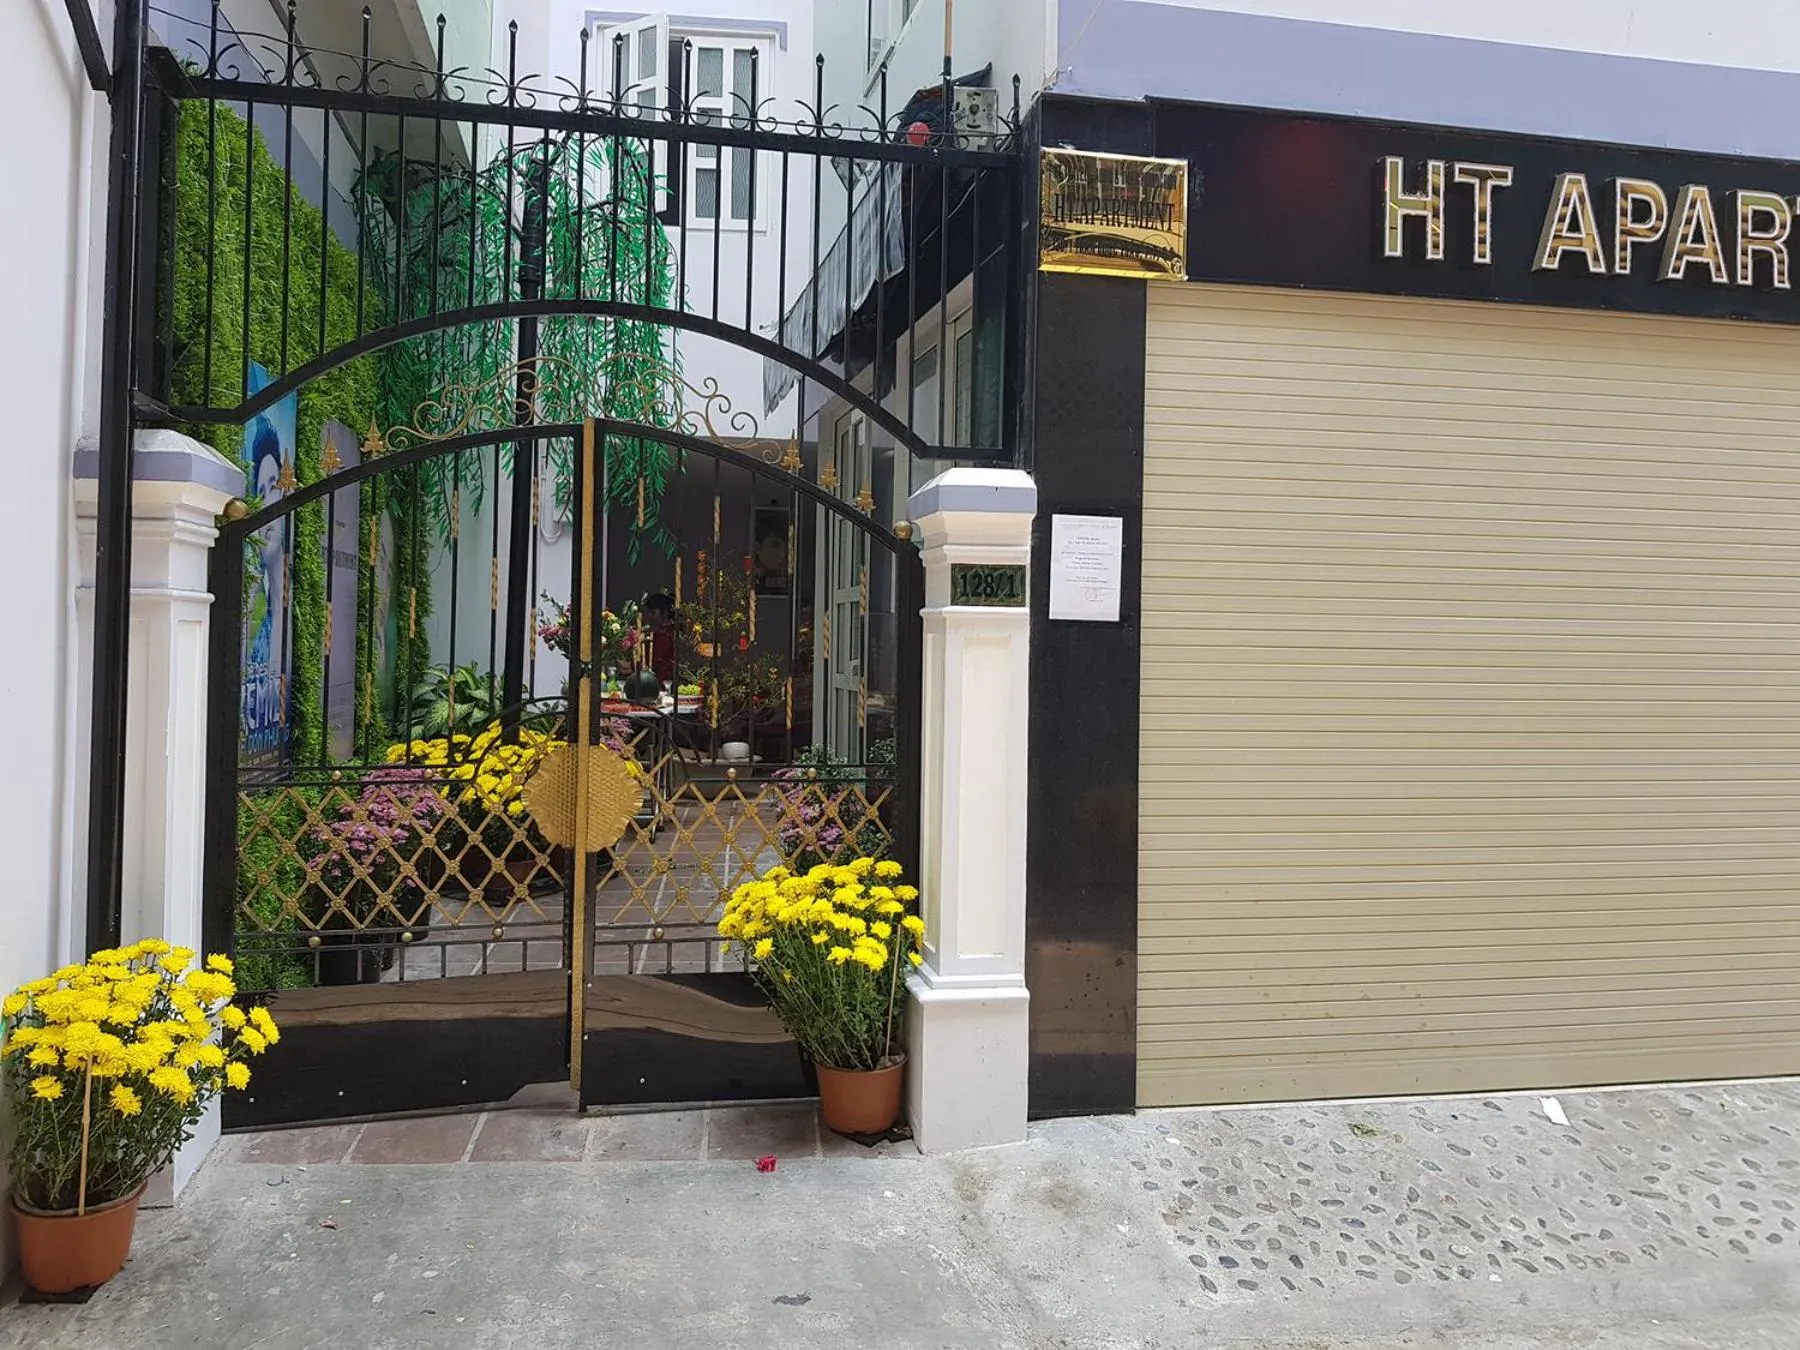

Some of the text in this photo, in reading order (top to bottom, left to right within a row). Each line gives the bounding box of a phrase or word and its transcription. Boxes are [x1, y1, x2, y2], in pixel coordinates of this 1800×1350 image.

[1382, 155, 1800, 289] HT APAR
[959, 572, 1018, 598] 128/1
